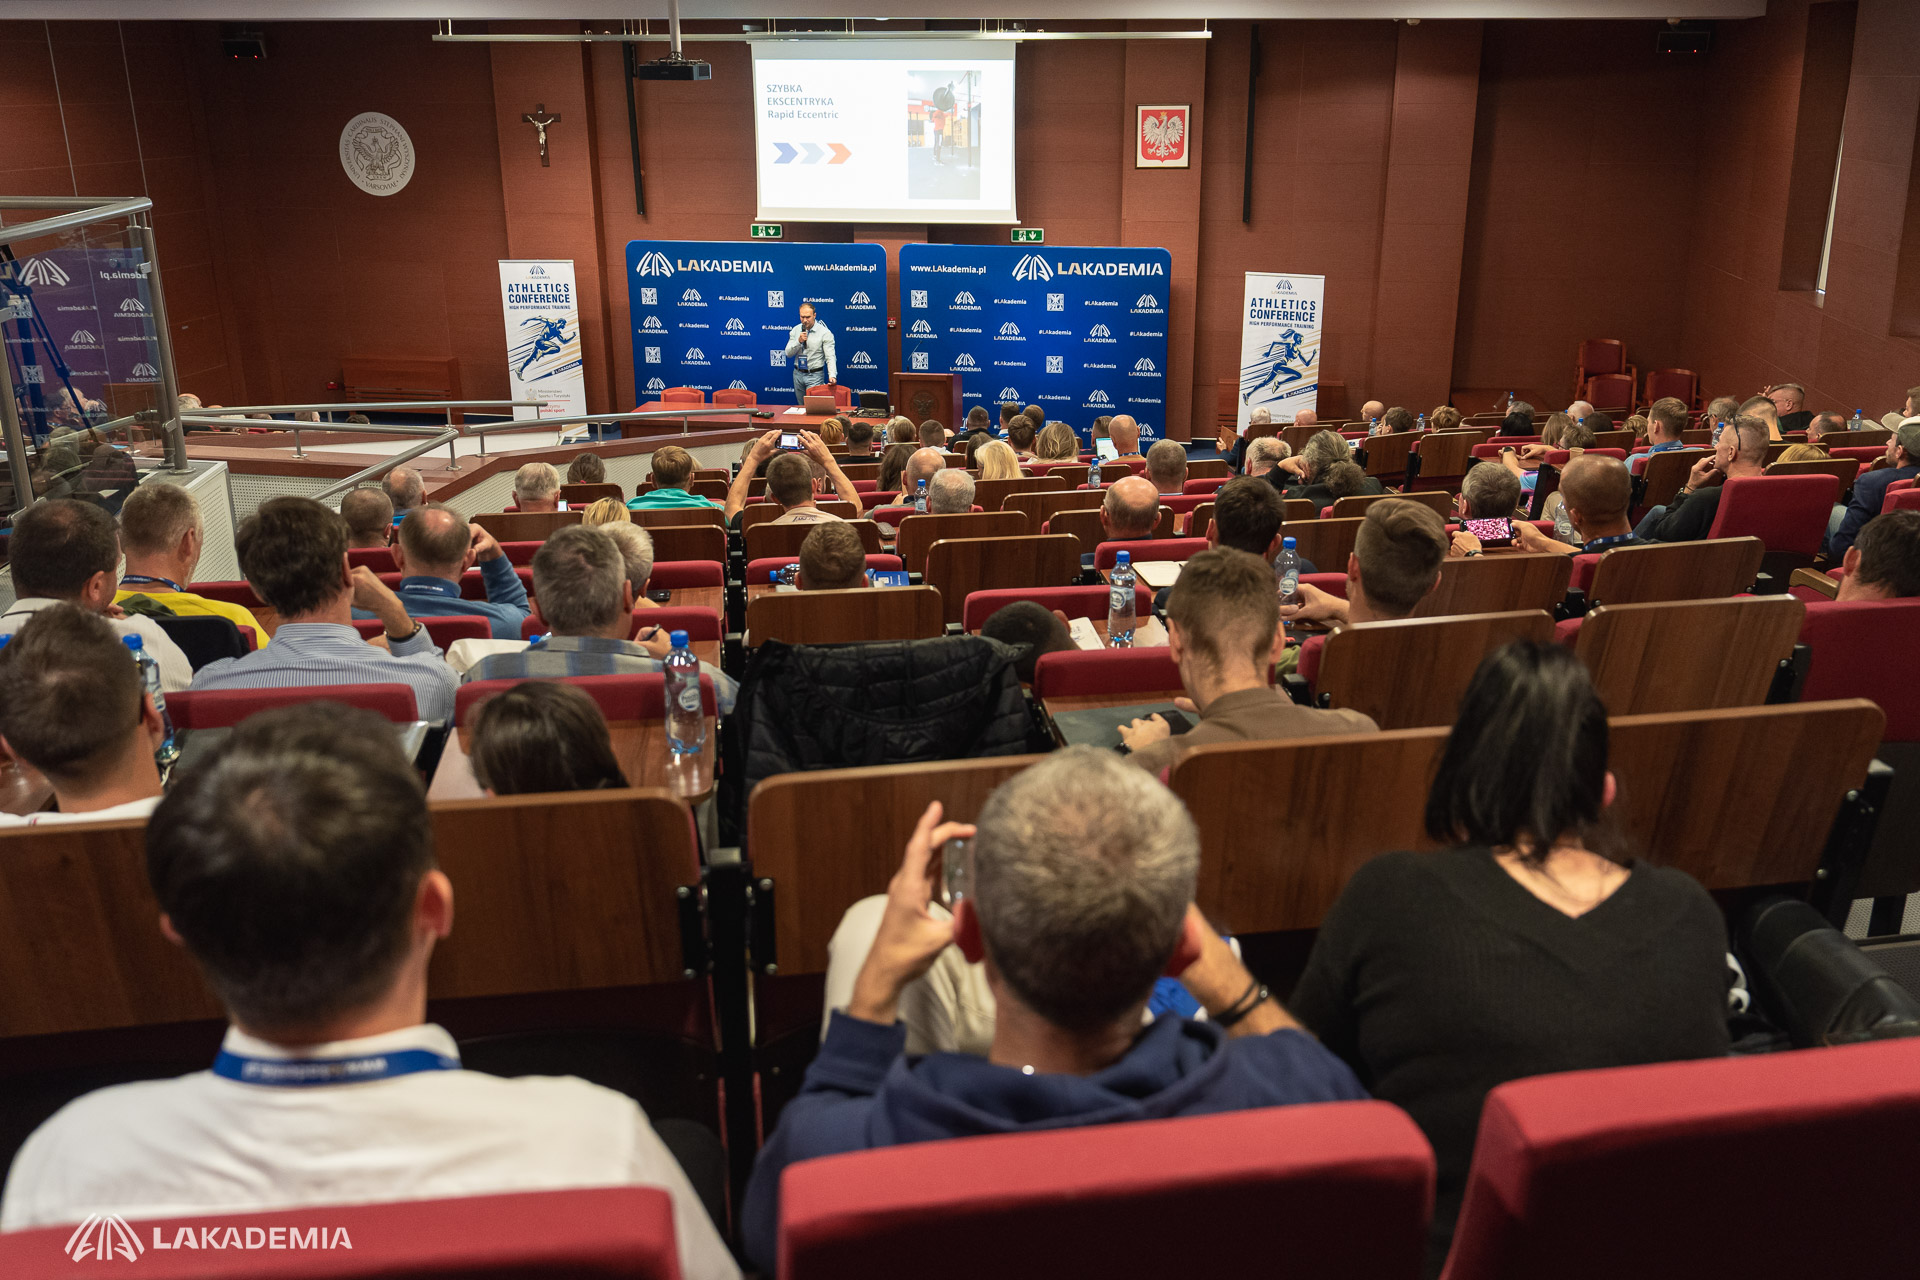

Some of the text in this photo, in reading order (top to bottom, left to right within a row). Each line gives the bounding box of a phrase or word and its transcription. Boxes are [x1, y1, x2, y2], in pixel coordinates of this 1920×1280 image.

[766, 84, 803, 93] SZYBKA
[767, 97, 834, 106] EKSCENTRYKA
[768, 110, 839, 120] Rapid Eccentric
[677, 259, 774, 273] LAKADEMIA
[804, 264, 877, 273] www.LAkademia.pl
[910, 265, 987, 275] www.LAkademia.pl
[1057, 262, 1164, 276] LAKADEMIA
[508, 284, 570, 293] ATHLETICS
[508, 294, 570, 304] CONFERENCE
[1250, 298, 1316, 311] ATHLETICS
[1249, 309, 1315, 322] CONFERENCE
